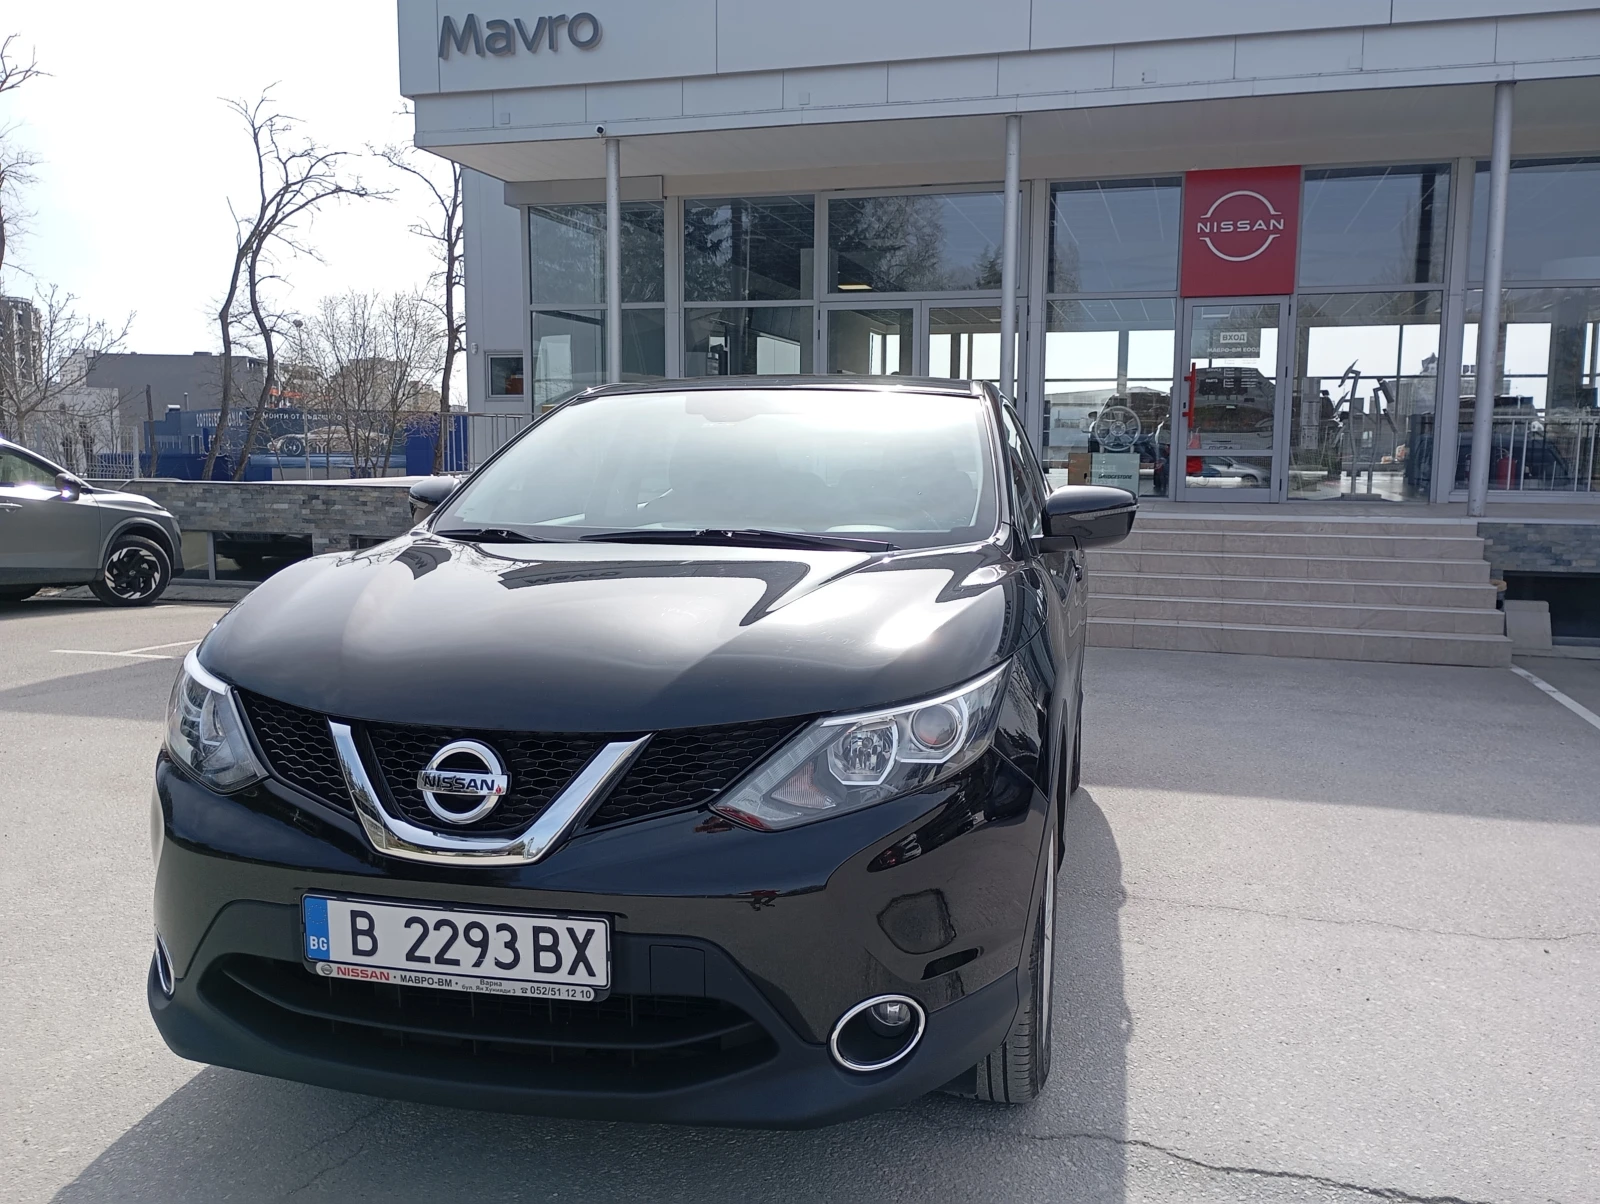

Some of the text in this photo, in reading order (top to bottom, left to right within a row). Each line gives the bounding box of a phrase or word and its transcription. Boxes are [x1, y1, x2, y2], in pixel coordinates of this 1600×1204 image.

[438, 11, 603, 60] Mavro
[1197, 218, 1285, 233] NISSAN
[196, 411, 243, 427] SOFTELECONIC
[423, 774, 496, 791] NISSAN
[350, 909, 379, 957] B
[309, 935, 328, 951] BG
[336, 966, 390, 982] NISSAN
[479, 978, 503, 987] Варна
[530, 985, 592, 999] 052/51 12 10
